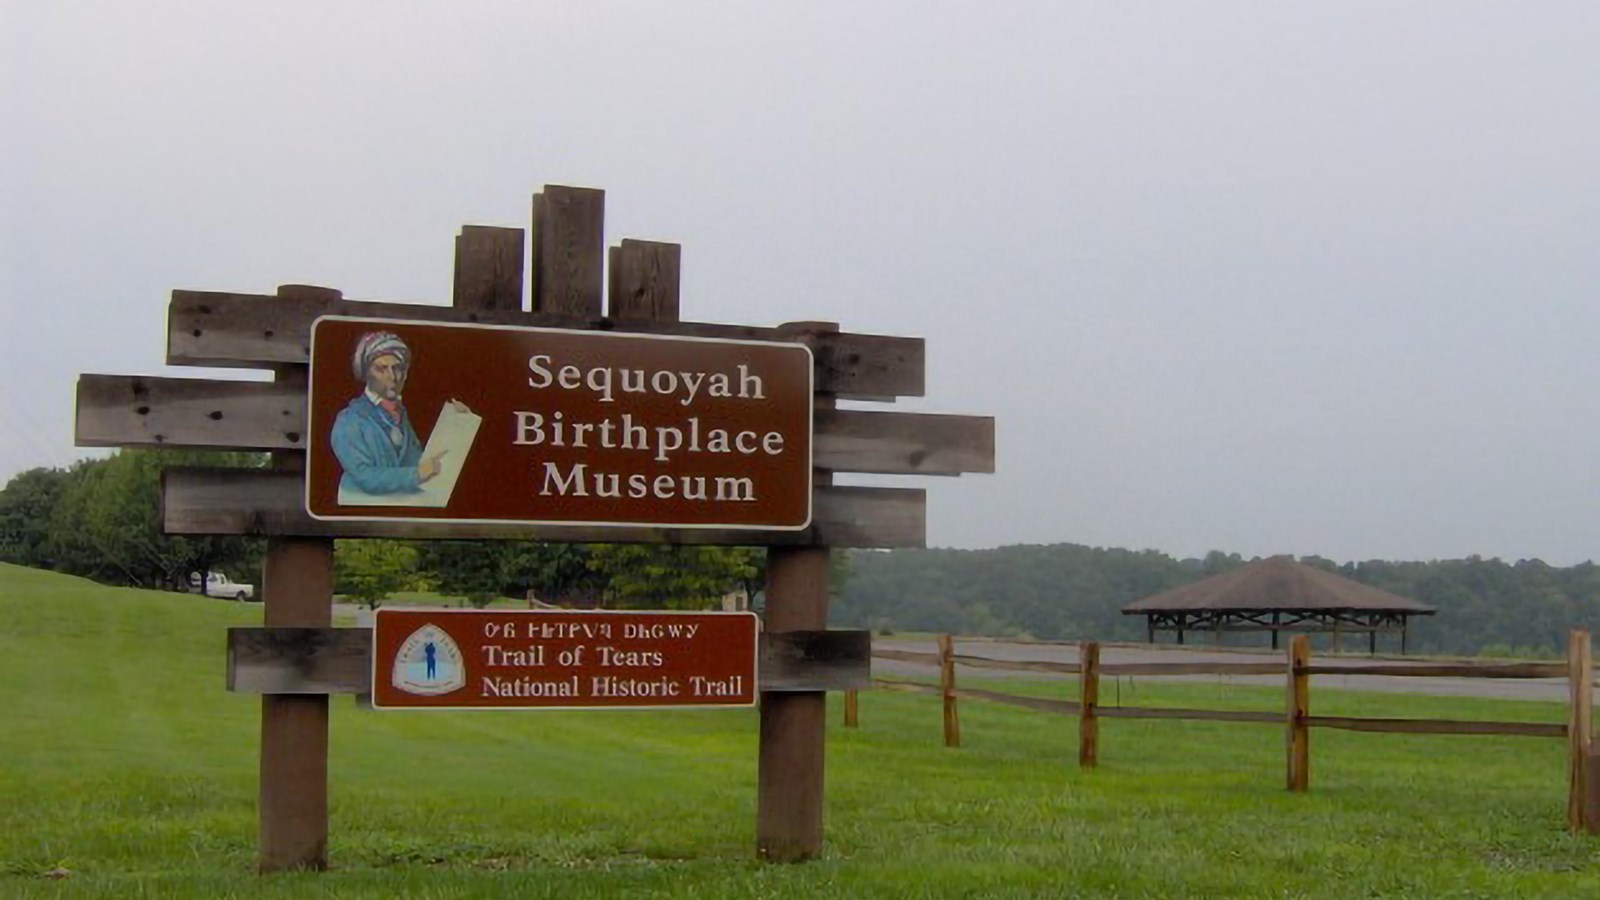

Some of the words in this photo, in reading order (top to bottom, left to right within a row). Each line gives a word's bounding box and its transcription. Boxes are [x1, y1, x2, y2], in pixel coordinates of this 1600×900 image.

[528, 354, 767, 407] Sequoyah
[512, 411, 784, 462] Birthplace
[539, 461, 757, 501] Museum
[481, 644, 545, 667] Trail
[558, 644, 586, 667] of
[595, 645, 664, 668] Tears
[481, 675, 580, 698] National
[590, 675, 681, 698] Historic
[689, 675, 743, 697] Trail
